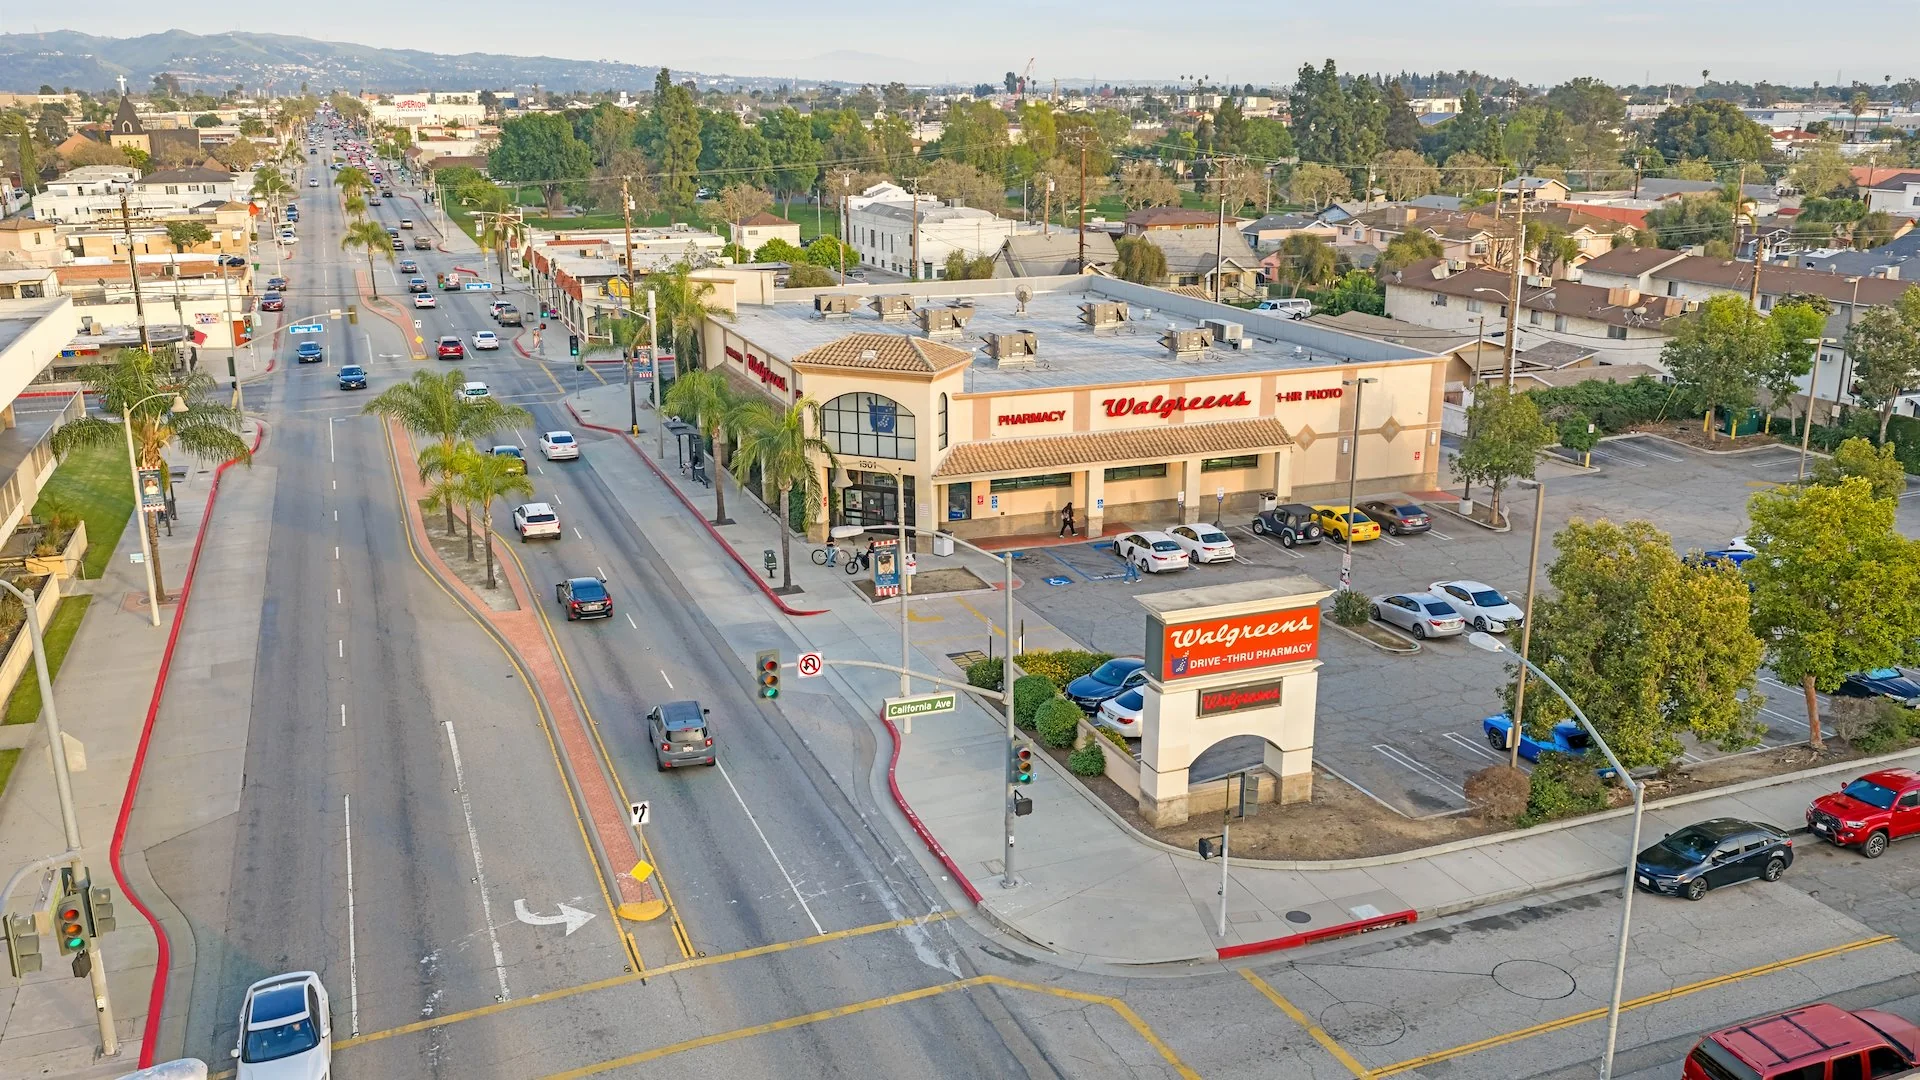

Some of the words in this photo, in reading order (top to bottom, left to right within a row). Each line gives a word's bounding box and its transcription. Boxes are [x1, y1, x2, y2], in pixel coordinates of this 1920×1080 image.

[396, 100, 426, 108] SUPERIOR
[57, 350, 81, 358] EXICO
[746, 353, 789, 392] Walgreens
[1275, 391, 1302, 403] 1-HR
[1305, 388, 1343, 401] PHOTO
[1102, 391, 1251, 419] Walgreens
[997, 410, 1066, 426] PHARMACY
[1170, 616, 1313, 648] Walgreens
[1256, 643, 1313, 660] PHARMACY
[890, 702, 932, 715] California
[934, 700, 952, 709] Ave
[1202, 688, 1280, 711] Walgreens
